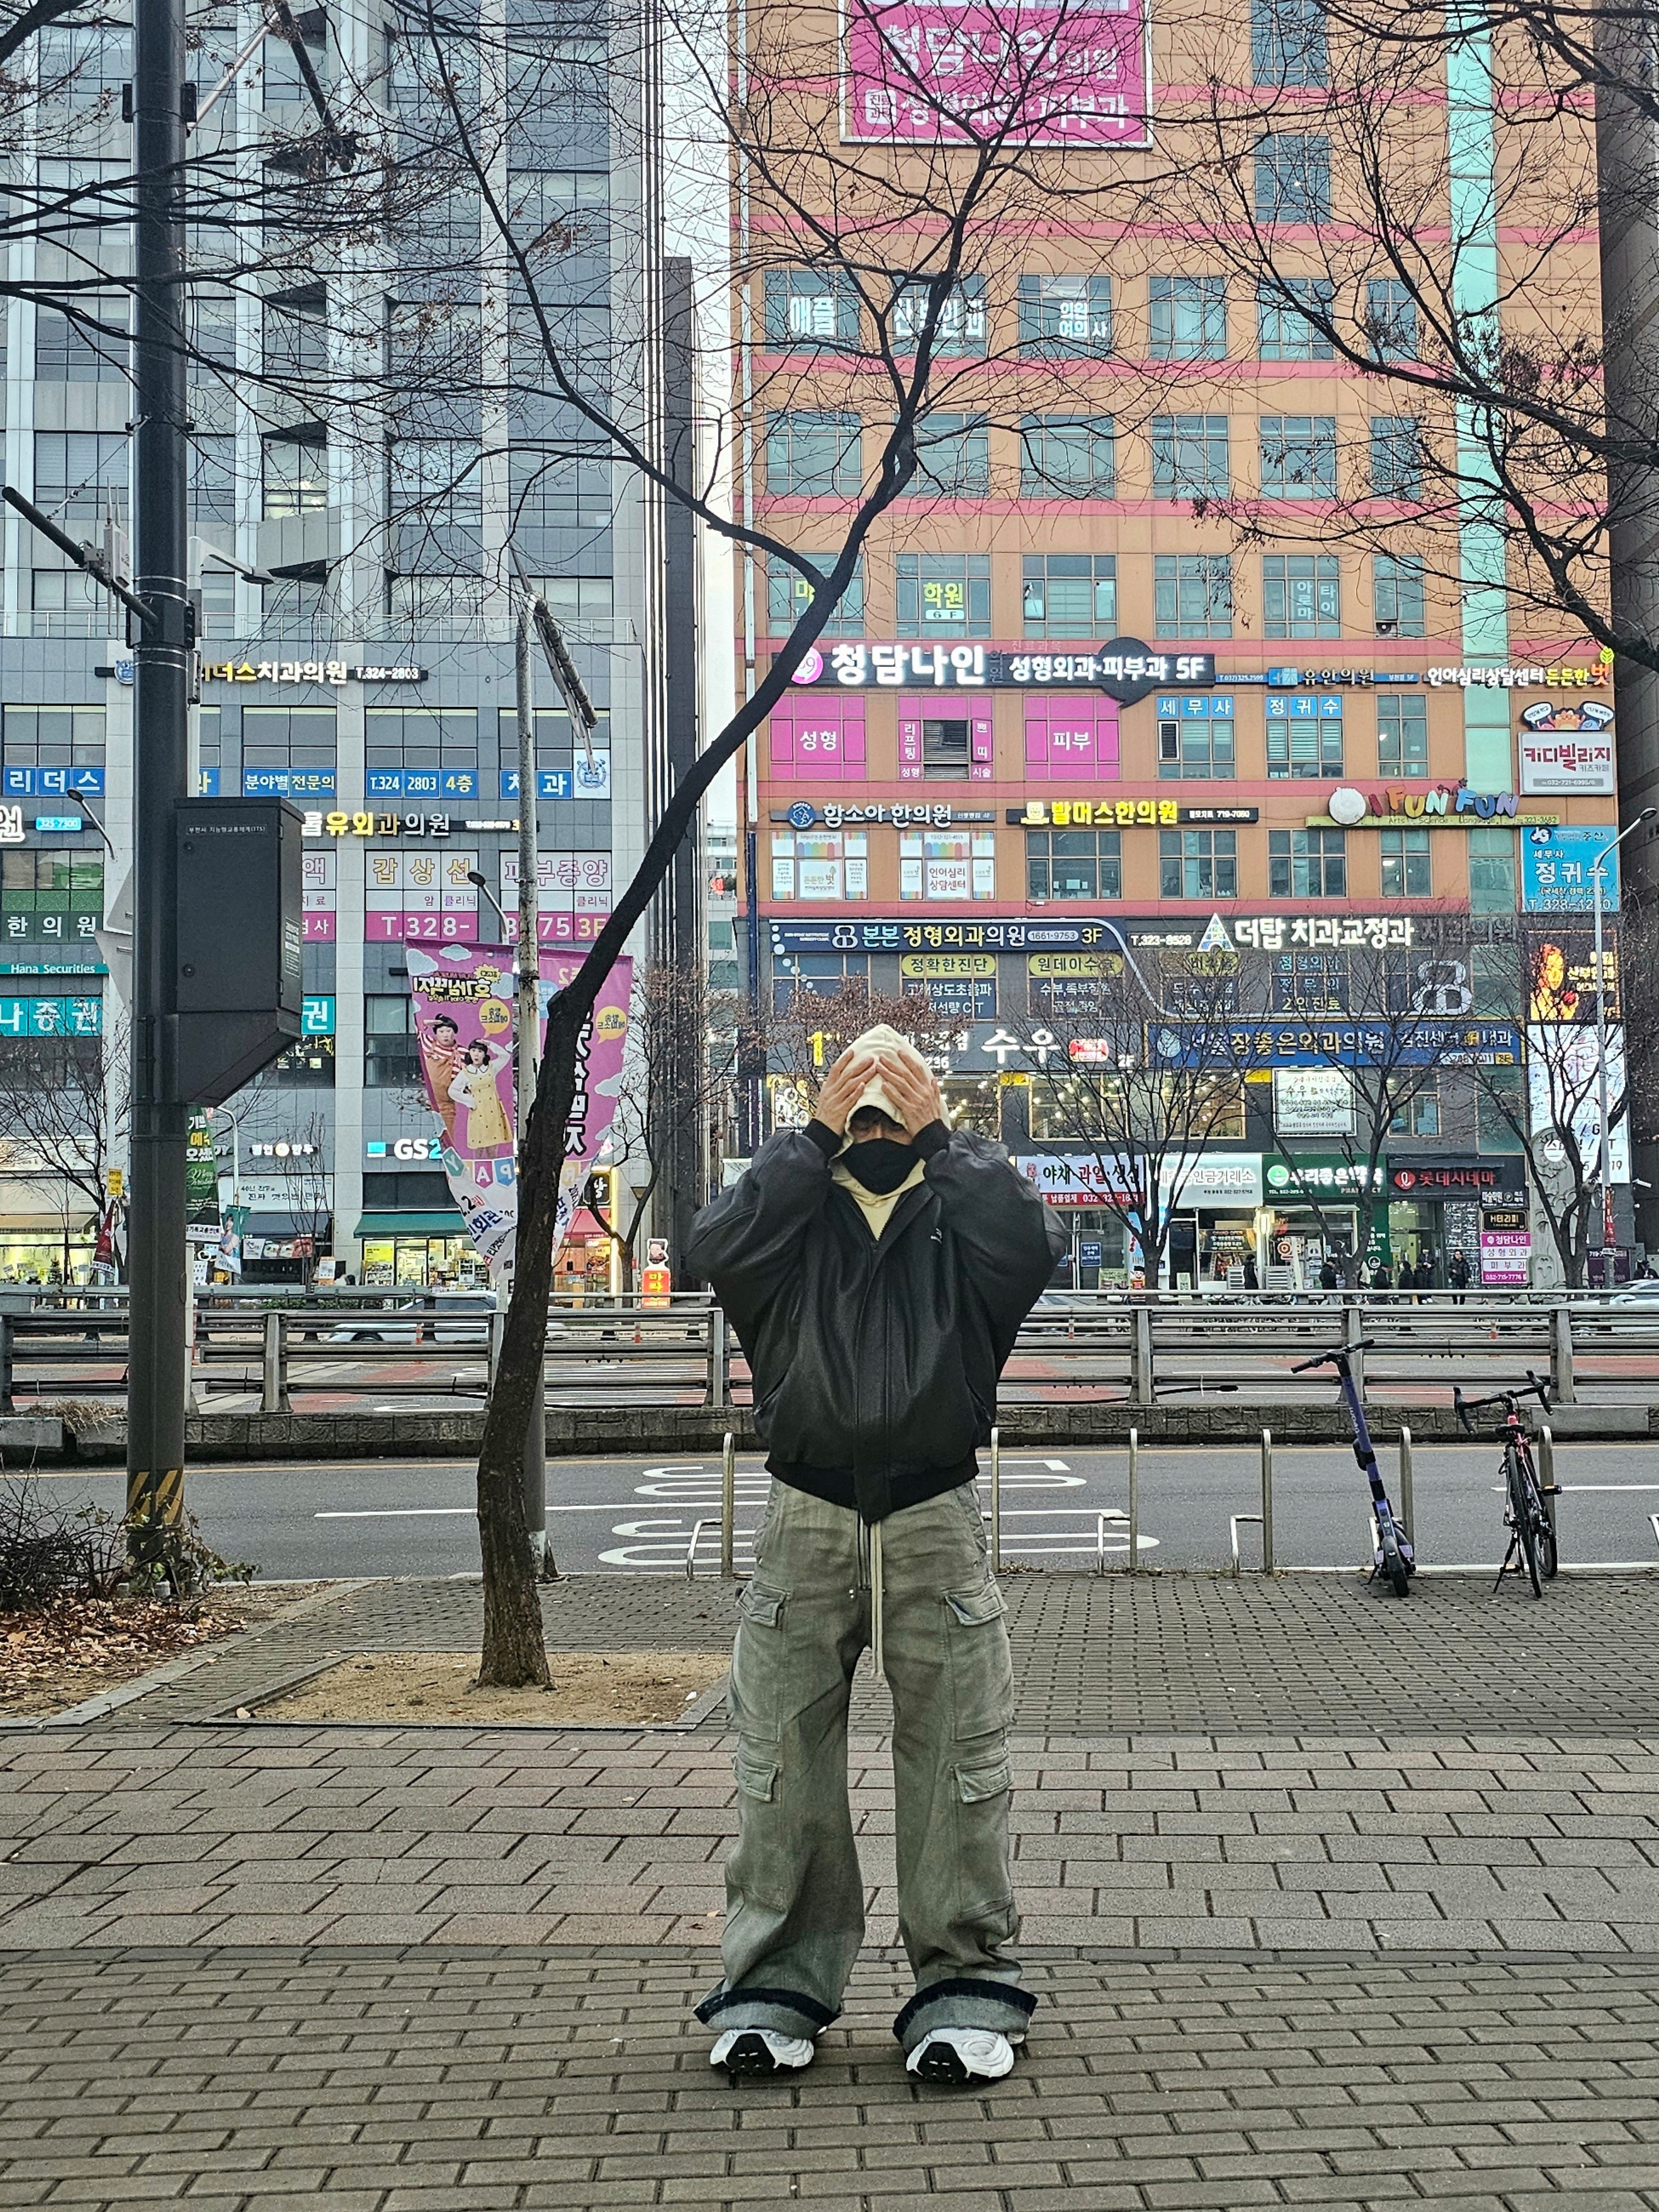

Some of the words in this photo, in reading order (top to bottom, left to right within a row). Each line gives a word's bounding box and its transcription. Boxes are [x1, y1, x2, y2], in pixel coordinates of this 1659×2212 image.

[789, 297, 835, 336] 애플
[1060, 302, 1089, 320] 의원
[1058, 321, 1108, 339] 여의사
[923, 582, 964, 609] 학원
[1297, 581, 1313, 620] 아로마
[1320, 584, 1337, 614] 타이
[831, 644, 984, 685] 청담나인
[1176, 657, 1205, 680] 5F
[1303, 668, 1375, 686] 휴한의원
[1428, 668, 1543, 687] 언어심리상담센터
[1546, 668, 1589, 686] 든든한
[1590, 664, 1610, 686] 벗
[1160, 698, 1230, 715] 세무사
[1269, 699, 1339, 715] 정귀수
[800, 731, 837, 750] 성형
[904, 723, 915, 760] 리프팅
[1053, 732, 1091, 750] 피부
[1524, 744, 1611, 772] 키디빌리지
[10, 770, 100, 793] 리더스
[245, 774, 288, 791] 분야별
[291, 774, 334, 791] 전문의
[369, 776, 400, 790] T.324
[408, 776, 436, 790] 2803
[445, 773, 473, 792] 4층
[901, 767, 920, 778] 성형
[972, 767, 991, 778] 시술
[1384, 784, 1449, 818] FUN
[1455, 788, 1519, 818] FUN
[823, 802, 886, 828] 함소아
[890, 803, 952, 828] 한의원
[1052, 800, 1178, 825] 발머스한의원
[1533, 849, 1564, 859] 세무사
[373, 858, 470, 885] 갑상선
[929, 867, 966, 879] 언어심리
[1534, 861, 1609, 884] 정귀수
[929, 880, 966, 892] 상담센터
[425, 896, 435, 906] 암
[444, 896, 476, 907] 클리닉
[577, 896, 608, 907] 클리닉
[7, 916, 97, 938] 한의원
[381, 916, 470, 937] T.328-
[862, 926, 900, 947] 본본
[903, 926, 1026, 948] 정형외과의원
[1081, 927, 1103, 944] 3F
[1234, 918, 1283, 949] 더탑
[1291, 916, 1416, 949] 치과교정과
[11, 964, 39, 974] Hana
[43, 964, 95, 974] Securities
[910, 958, 988, 973] 정확한진단
[980, 1029, 1062, 1064] 수우
[393, 1138, 443, 1160] GS2
[1043, 1164, 1070, 1185] 야채
[1418, 1171, 1496, 1187] 롯데시네마
[1496, 1234, 1526, 1245] 청담나인
